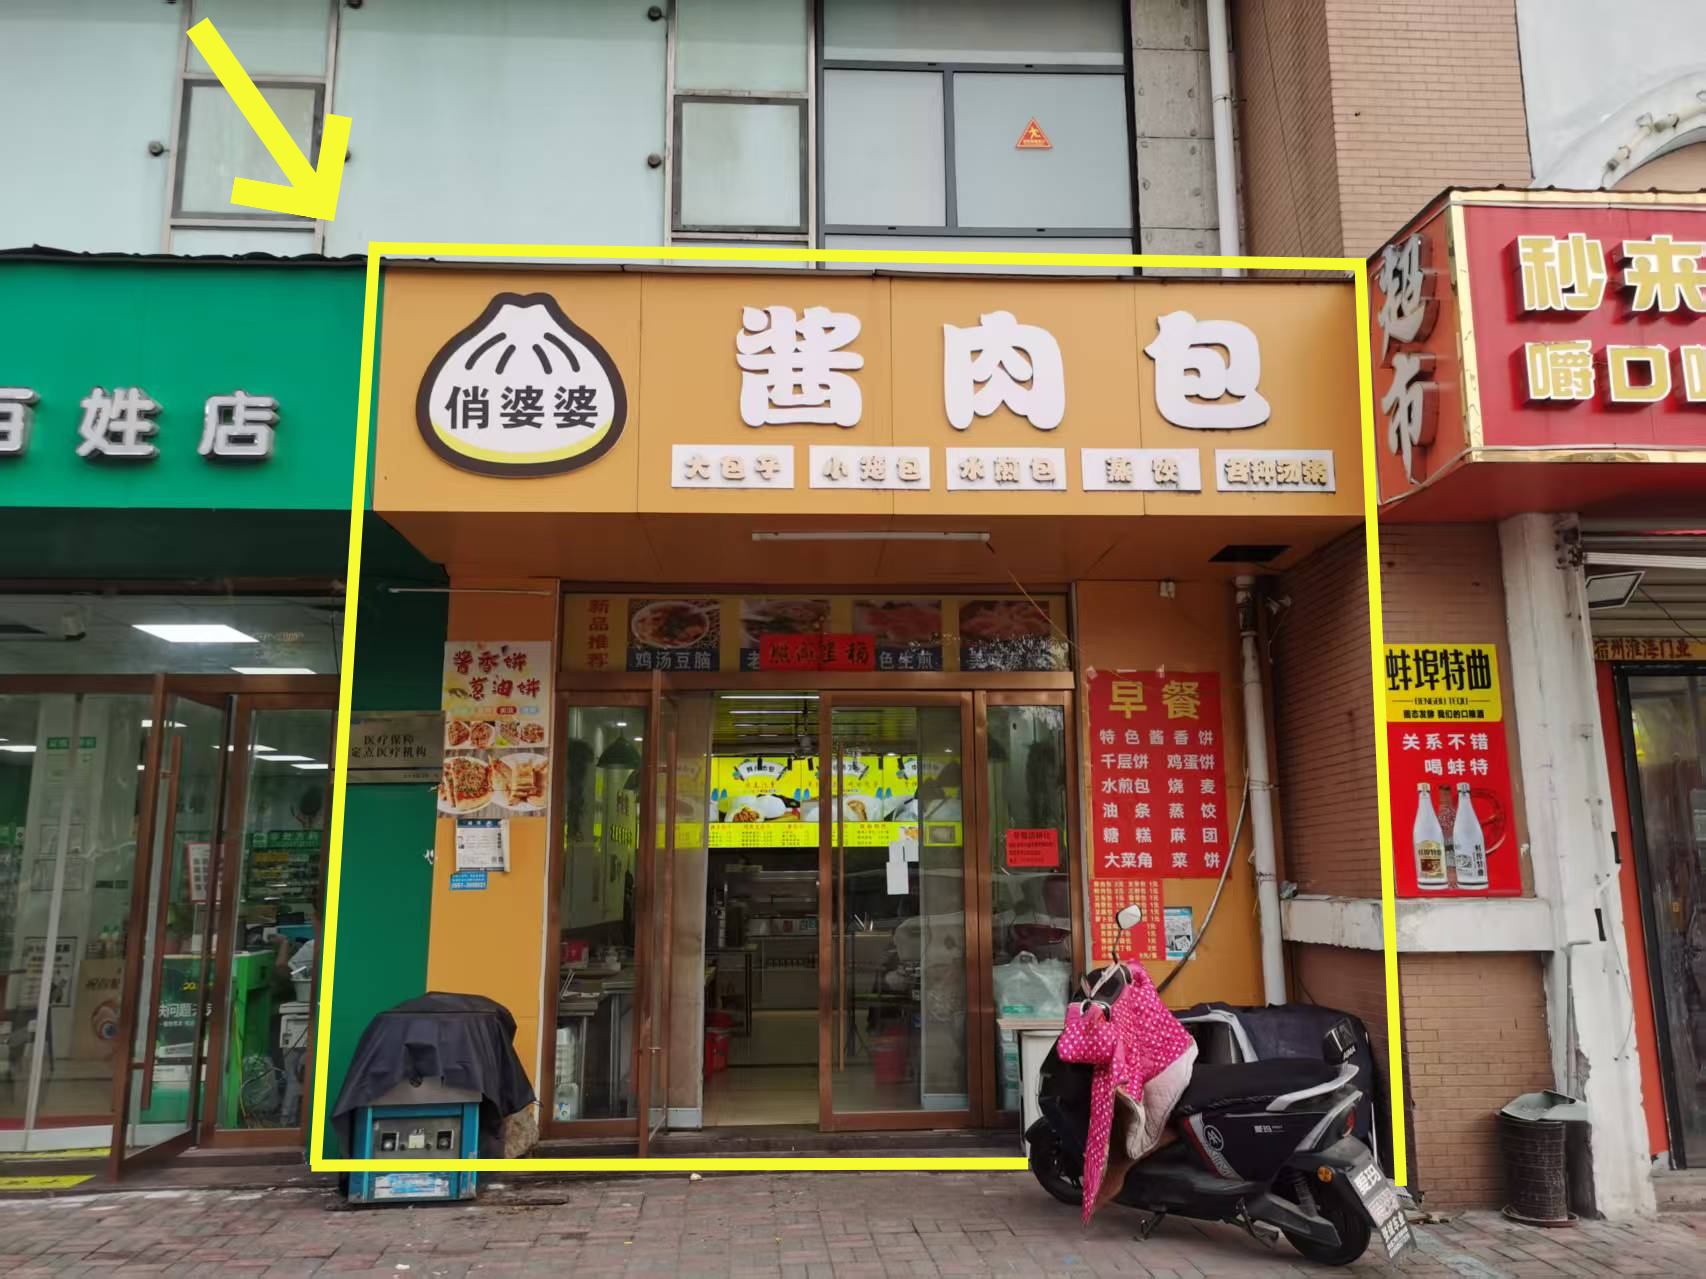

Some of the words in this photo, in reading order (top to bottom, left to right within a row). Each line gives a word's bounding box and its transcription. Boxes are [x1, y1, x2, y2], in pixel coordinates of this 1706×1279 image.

[735, 304, 1272, 430] 酱肉包
[444, 385, 598, 429] 俏婆婆
[684, 454, 781, 481] 大包子
[957, 456, 1056, 483] 水煎包
[1103, 456, 1179, 484] 蒸饺
[1223, 457, 1329, 486] 各种汤粥
[587, 599, 609, 669] 新品推荐
[635, 650, 712, 670] 鸡汤豆脑
[1385, 648, 1492, 691] 蚌埠特曲
[1108, 679, 1201, 720] 早餐
[1099, 728, 1214, 746] 特色酱香饼
[1401, 732, 1489, 751] 关系不错
[1101, 753, 1149, 770] 千层饼
[1167, 753, 1215, 770] 鸡蛋饼
[1424, 758, 1489, 776] 喝蚌特
[1102, 778, 1150, 794] 水煎包
[1168, 778, 1216, 794] 烧麦
[1103, 803, 1151, 819] 油条
[1168, 803, 1217, 819] 蒸饺
[1170, 827, 1218, 844] 麻团
[1104, 852, 1153, 869] 大菜角
[1171, 852, 1221, 869] 菜饼
